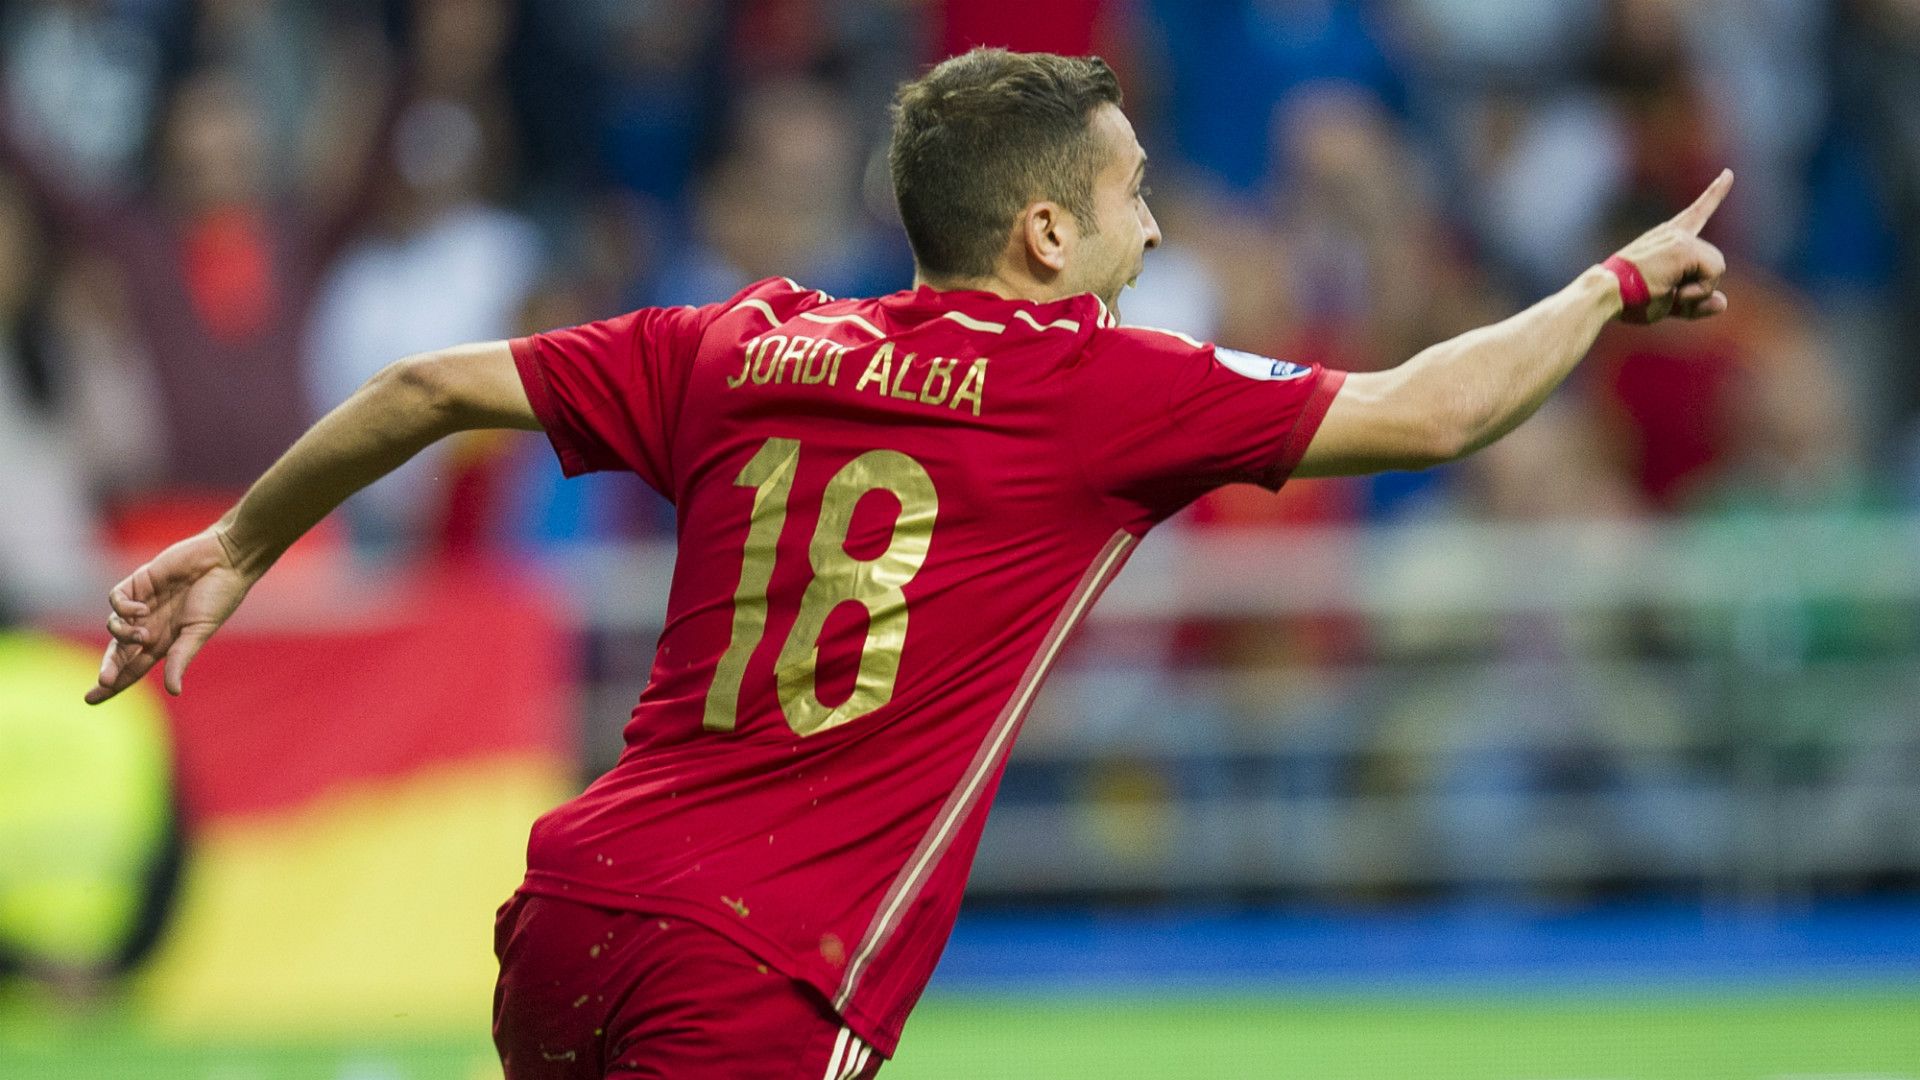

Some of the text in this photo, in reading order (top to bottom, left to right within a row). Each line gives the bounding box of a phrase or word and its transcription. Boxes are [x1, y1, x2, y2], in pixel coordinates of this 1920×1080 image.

[727, 335, 989, 416] JORDI ALBA
[702, 437, 939, 737] 18
